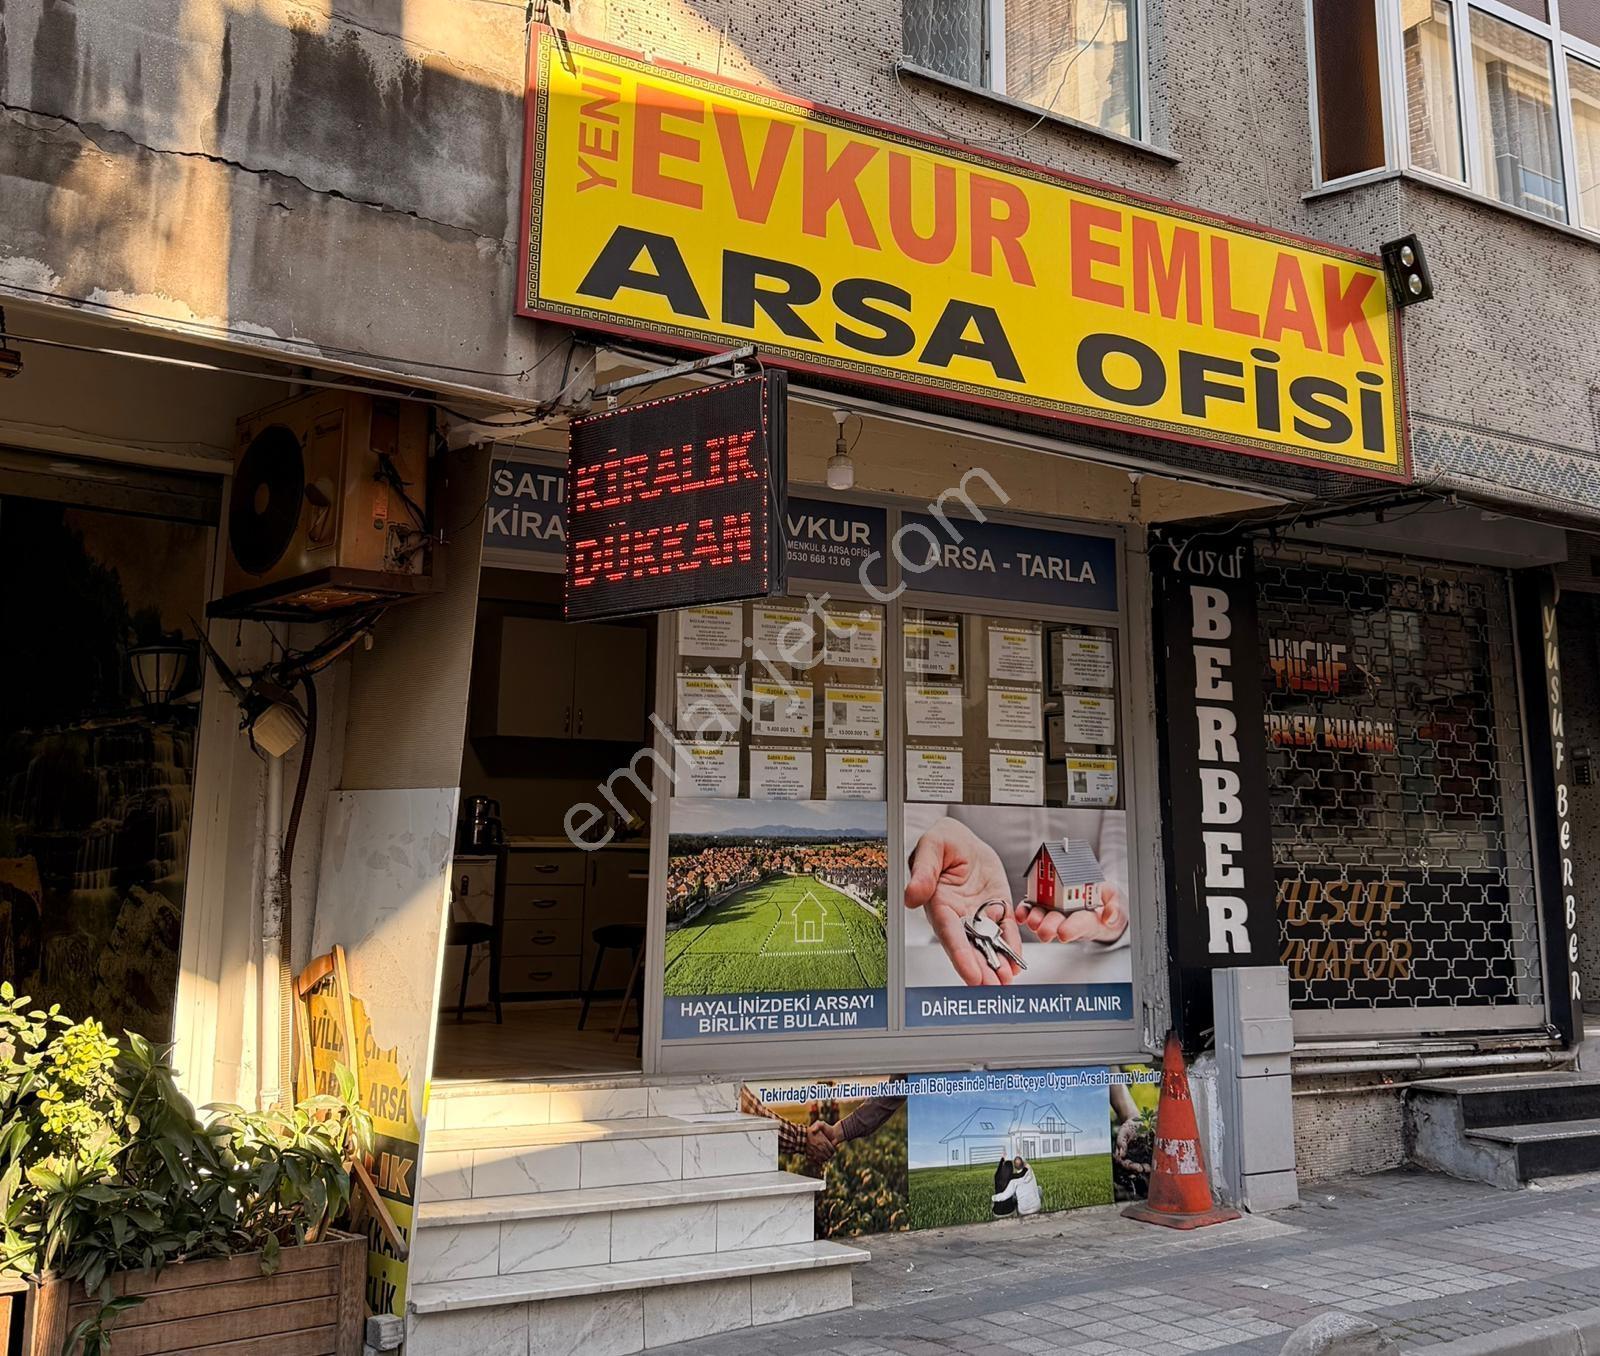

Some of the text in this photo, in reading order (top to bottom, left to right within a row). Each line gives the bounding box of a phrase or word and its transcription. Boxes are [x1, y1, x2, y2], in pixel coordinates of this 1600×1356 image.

[632, 82, 1384, 366] EVKUR EMLAK
[576, 225, 1385, 453] ARSA OFİSİ
[787, 551, 808, 562] 0530
[829, 556, 839, 565] 13
[840, 558, 851, 567] 06
[821, 544, 827, 553] &
[828, 545, 850, 555] ARSA
[924, 542, 996, 573] ARSA
[1016, 552, 1097, 584] TARLA
[1168, 536, 1247, 580] Yusuf
[1190, 585, 1252, 954] BERBER
[680, 994, 875, 1017] HAYALİNİZDEKİ ARSAYI
[698, 1011, 858, 1033] BİRLİKTE BULALIM
[921, 993, 1122, 1017] DAİRELERİNİZ NAKİT ALINIR
[930, 1076, 986, 1097] Bölgesinde
[987, 1075, 1005, 1090] Her
[1007, 1074, 1046, 1093] Bütçeye
[1048, 1073, 1079, 1091] Uygun
[1079, 1070, 1132, 1086] Arsalarımız
[368, 1082, 407, 1124] ARSA
